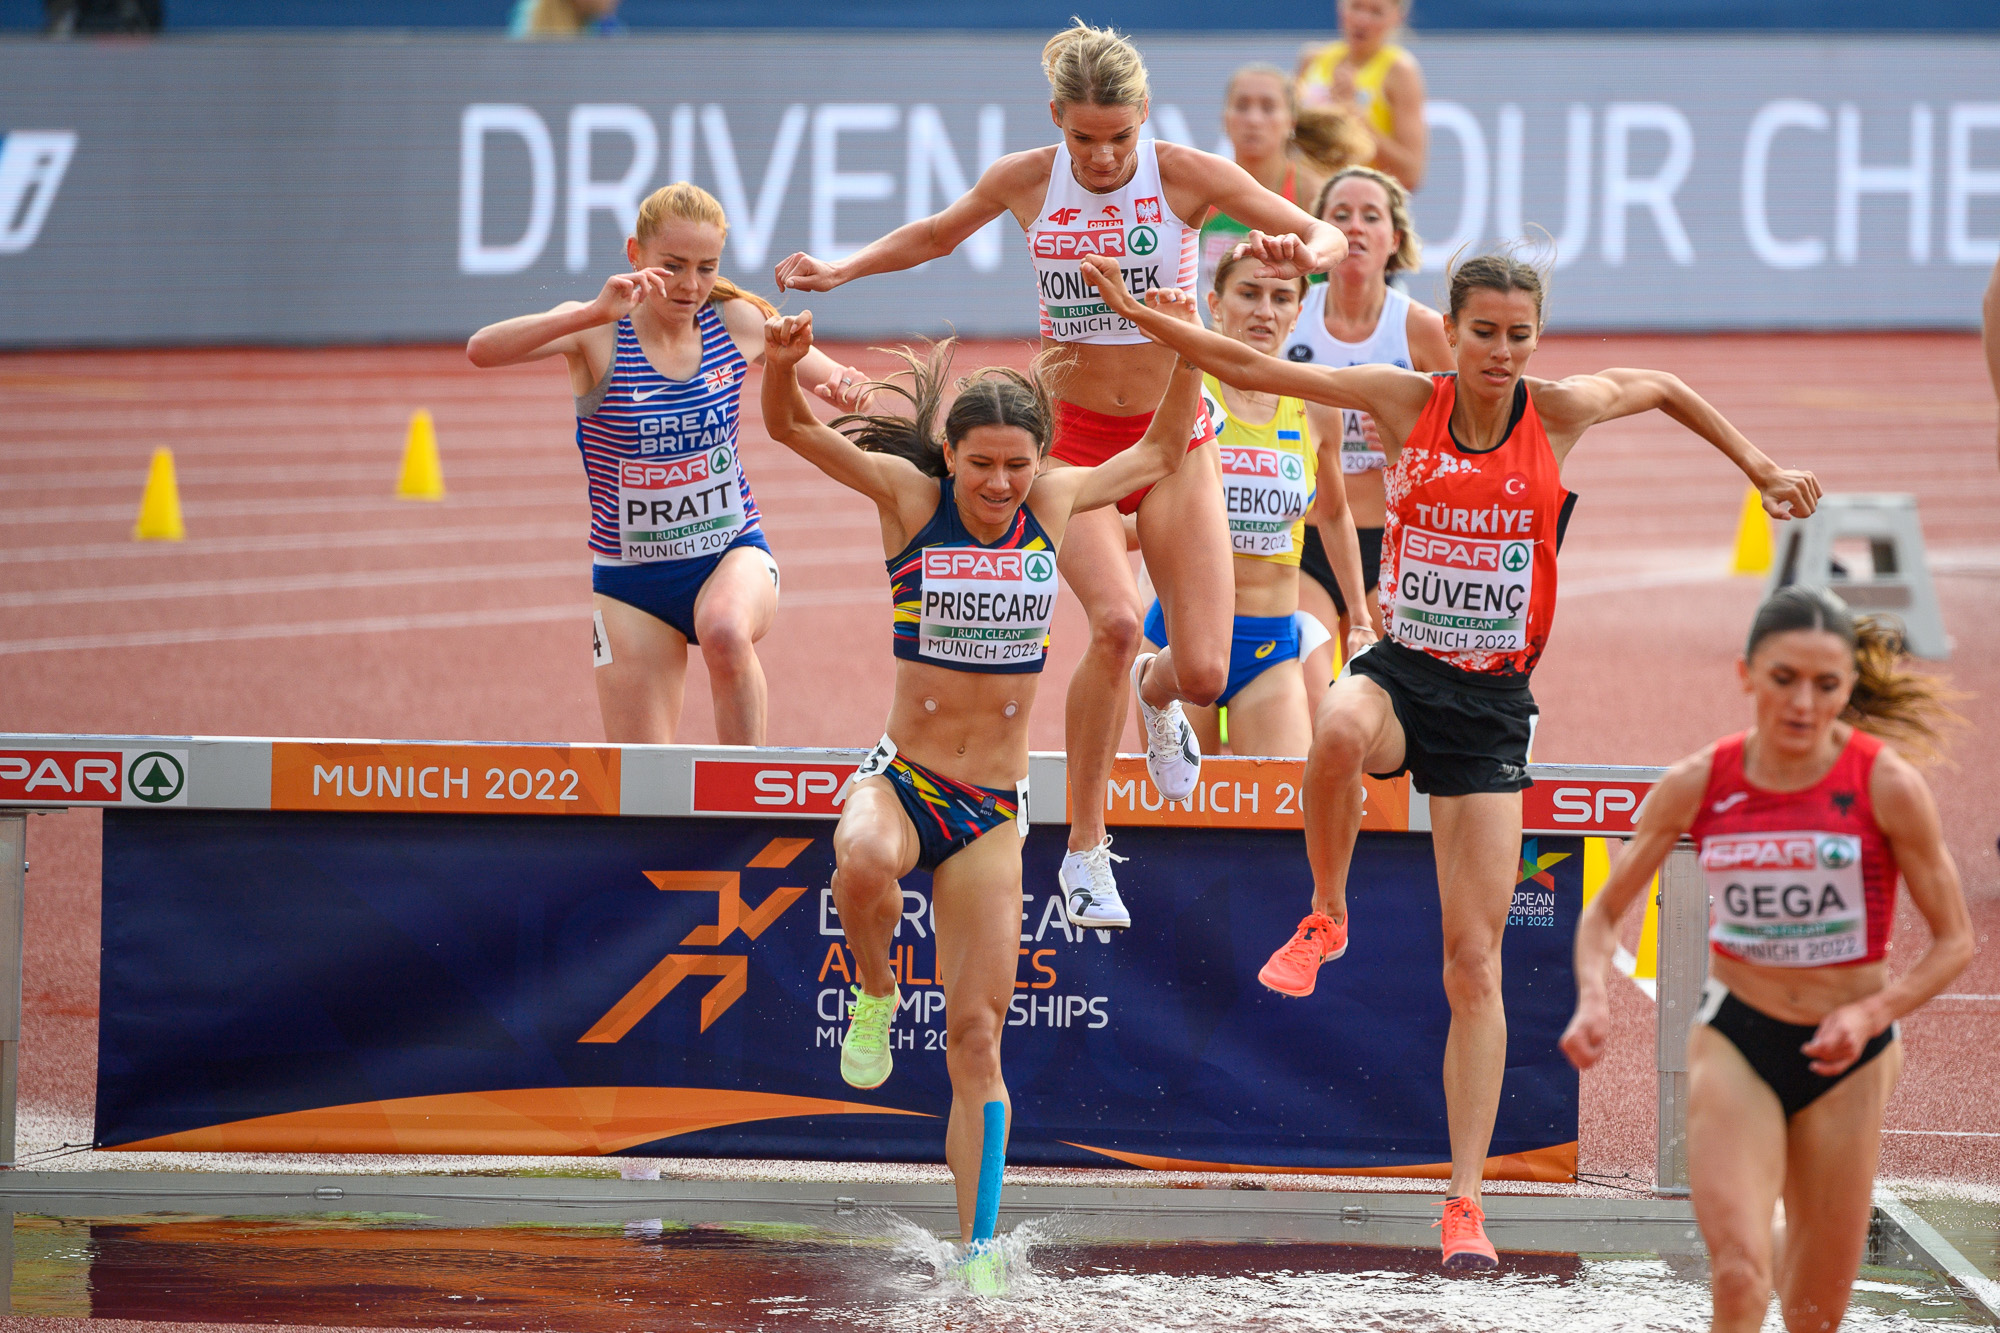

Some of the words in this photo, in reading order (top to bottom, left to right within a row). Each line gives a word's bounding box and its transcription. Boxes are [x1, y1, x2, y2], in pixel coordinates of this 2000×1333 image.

[459, 101, 1003, 274] DRIVEN
[1412, 100, 1696, 272] OUR
[1741, 99, 2000, 270] CHE
[1048, 207, 1082, 225] 4F
[1036, 233, 1123, 256] SPAR
[1062, 308, 1066, 317] I
[1069, 305, 1093, 317] RUN
[640, 402, 730, 436] GREAT
[640, 427, 730, 455] BRITAIN
[623, 458, 708, 486] SPAR
[1220, 451, 1277, 474] PAR
[627, 481, 732, 525] PRATT
[1223, 486, 1302, 517] EBKOVA
[1416, 502, 1534, 533] TÜRKİYE
[629, 539, 695, 558] MUNICH
[656, 529, 679, 541] RUN
[1406, 535, 1497, 568] SPAR
[928, 553, 1020, 578] SPAR
[925, 591, 1052, 622] PRISECARU
[1402, 571, 1525, 618] GÜVENÇ
[1422, 612, 1426, 621] I
[1428, 614, 1453, 626] RUN
[951, 628, 955, 638] I
[958, 628, 982, 639] RUN
[1399, 622, 1468, 648] MUNICH
[1474, 635, 1516, 649] 2022
[928, 639, 997, 659] MUNICH
[1002, 642, 1039, 659] 2022
[313, 764, 469, 798] MUNICH
[485, 768, 579, 801] 2022
[1710, 840, 1814, 867] SPAR
[1510, 892, 1555, 906] OPEAN
[1724, 883, 1847, 917] GEGA
[1527, 916, 1554, 927] 2022
